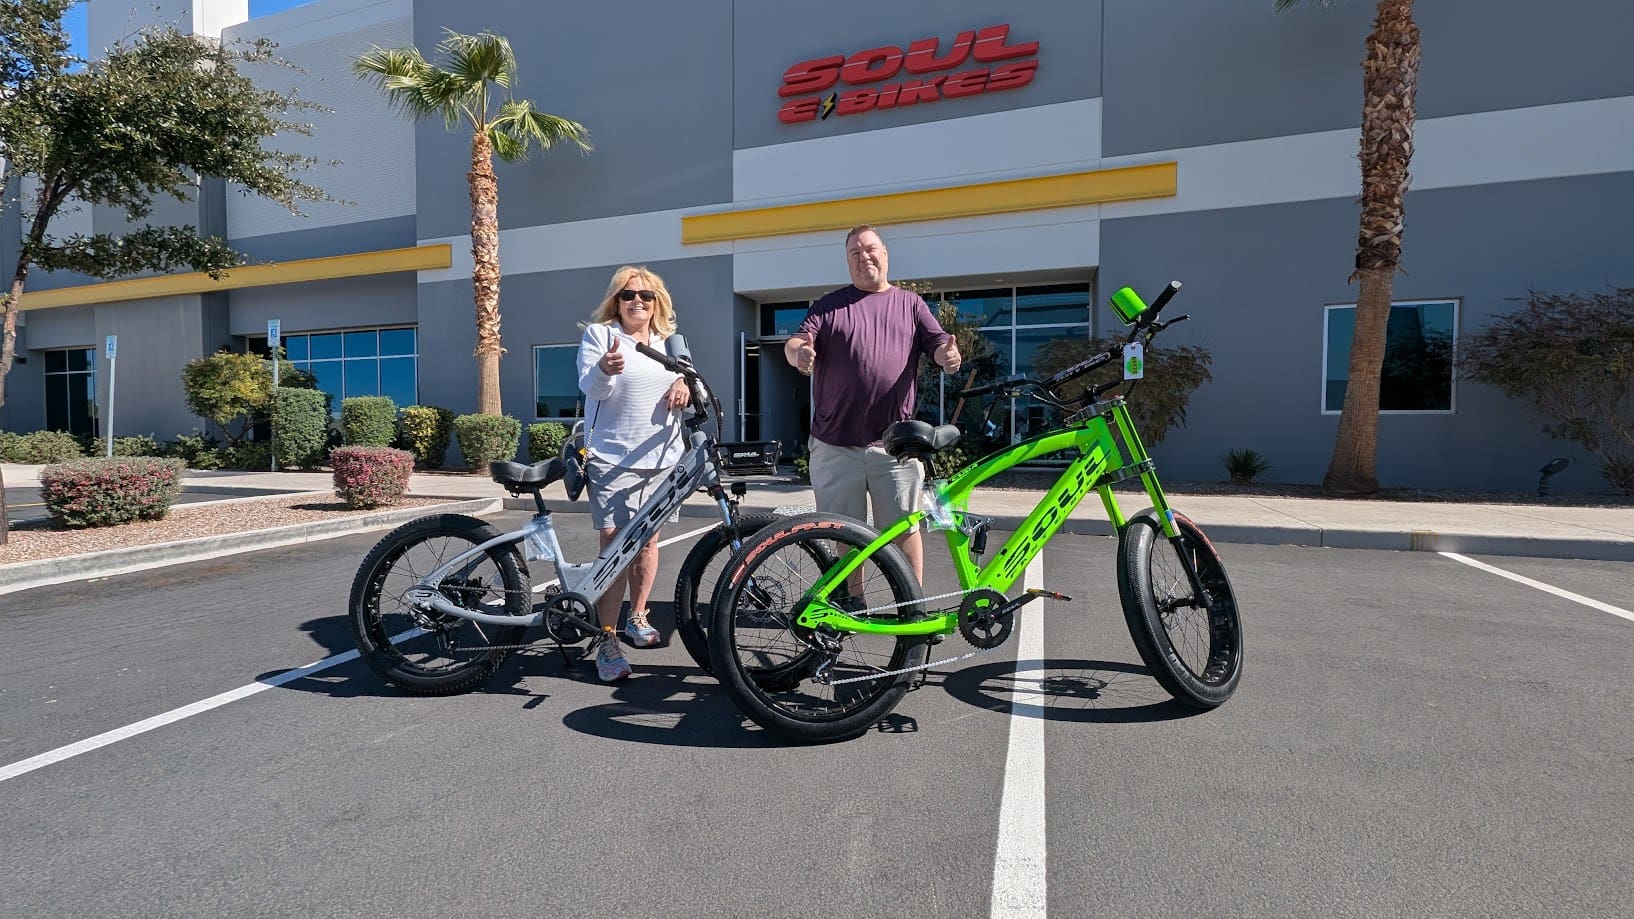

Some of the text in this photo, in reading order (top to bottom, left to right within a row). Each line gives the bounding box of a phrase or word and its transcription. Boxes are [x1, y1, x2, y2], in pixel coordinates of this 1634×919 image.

[778, 24, 1040, 98] SOUL
[593, 466, 699, 590] SOUL
[1004, 449, 1110, 578] SOUL
